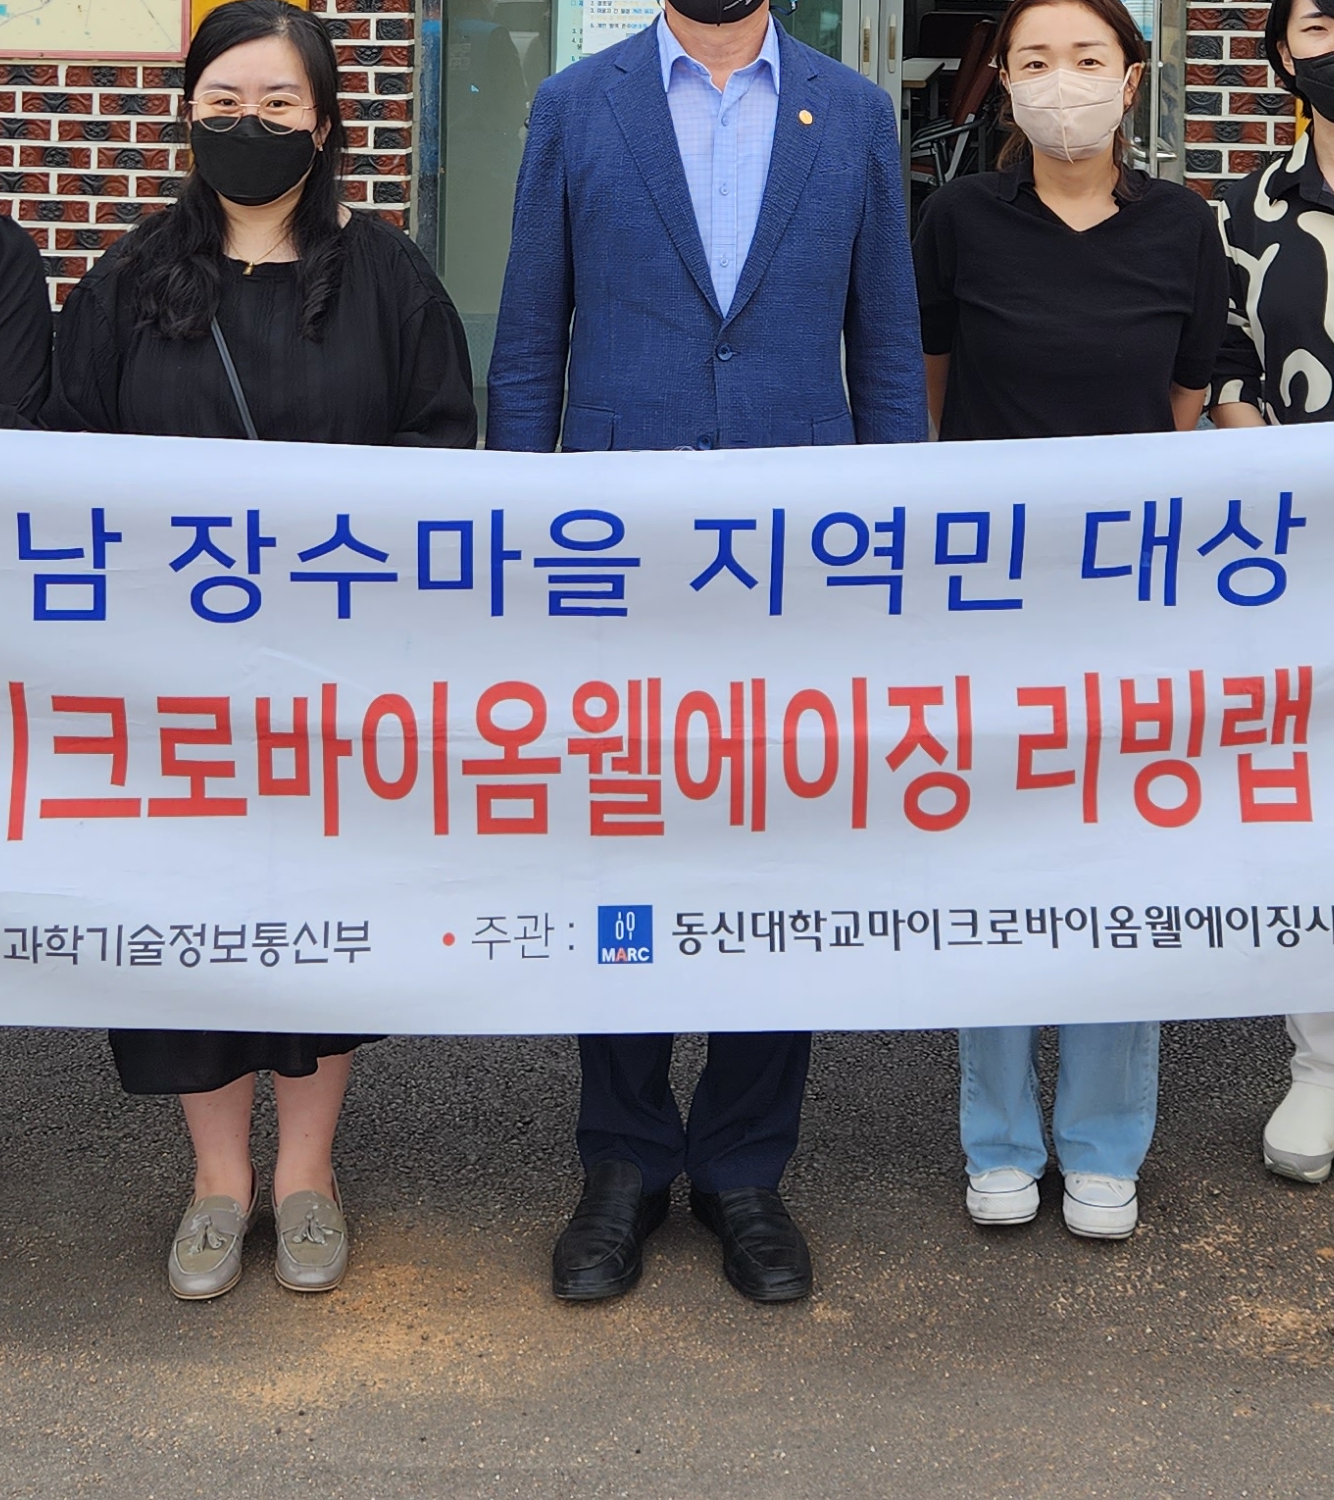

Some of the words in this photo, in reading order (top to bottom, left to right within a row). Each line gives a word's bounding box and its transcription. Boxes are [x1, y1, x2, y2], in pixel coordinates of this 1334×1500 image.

[168, 508, 641, 624] 장수마을
[689, 503, 1027, 617] 지역민
[1080, 491, 1307, 608] 대상
[1014, 665, 1313, 830] 리빙랩
[2, 920, 372, 968] 과학기술정보통신부
[471, 911, 555, 961] 주관
[601, 946, 651, 963] MARC
